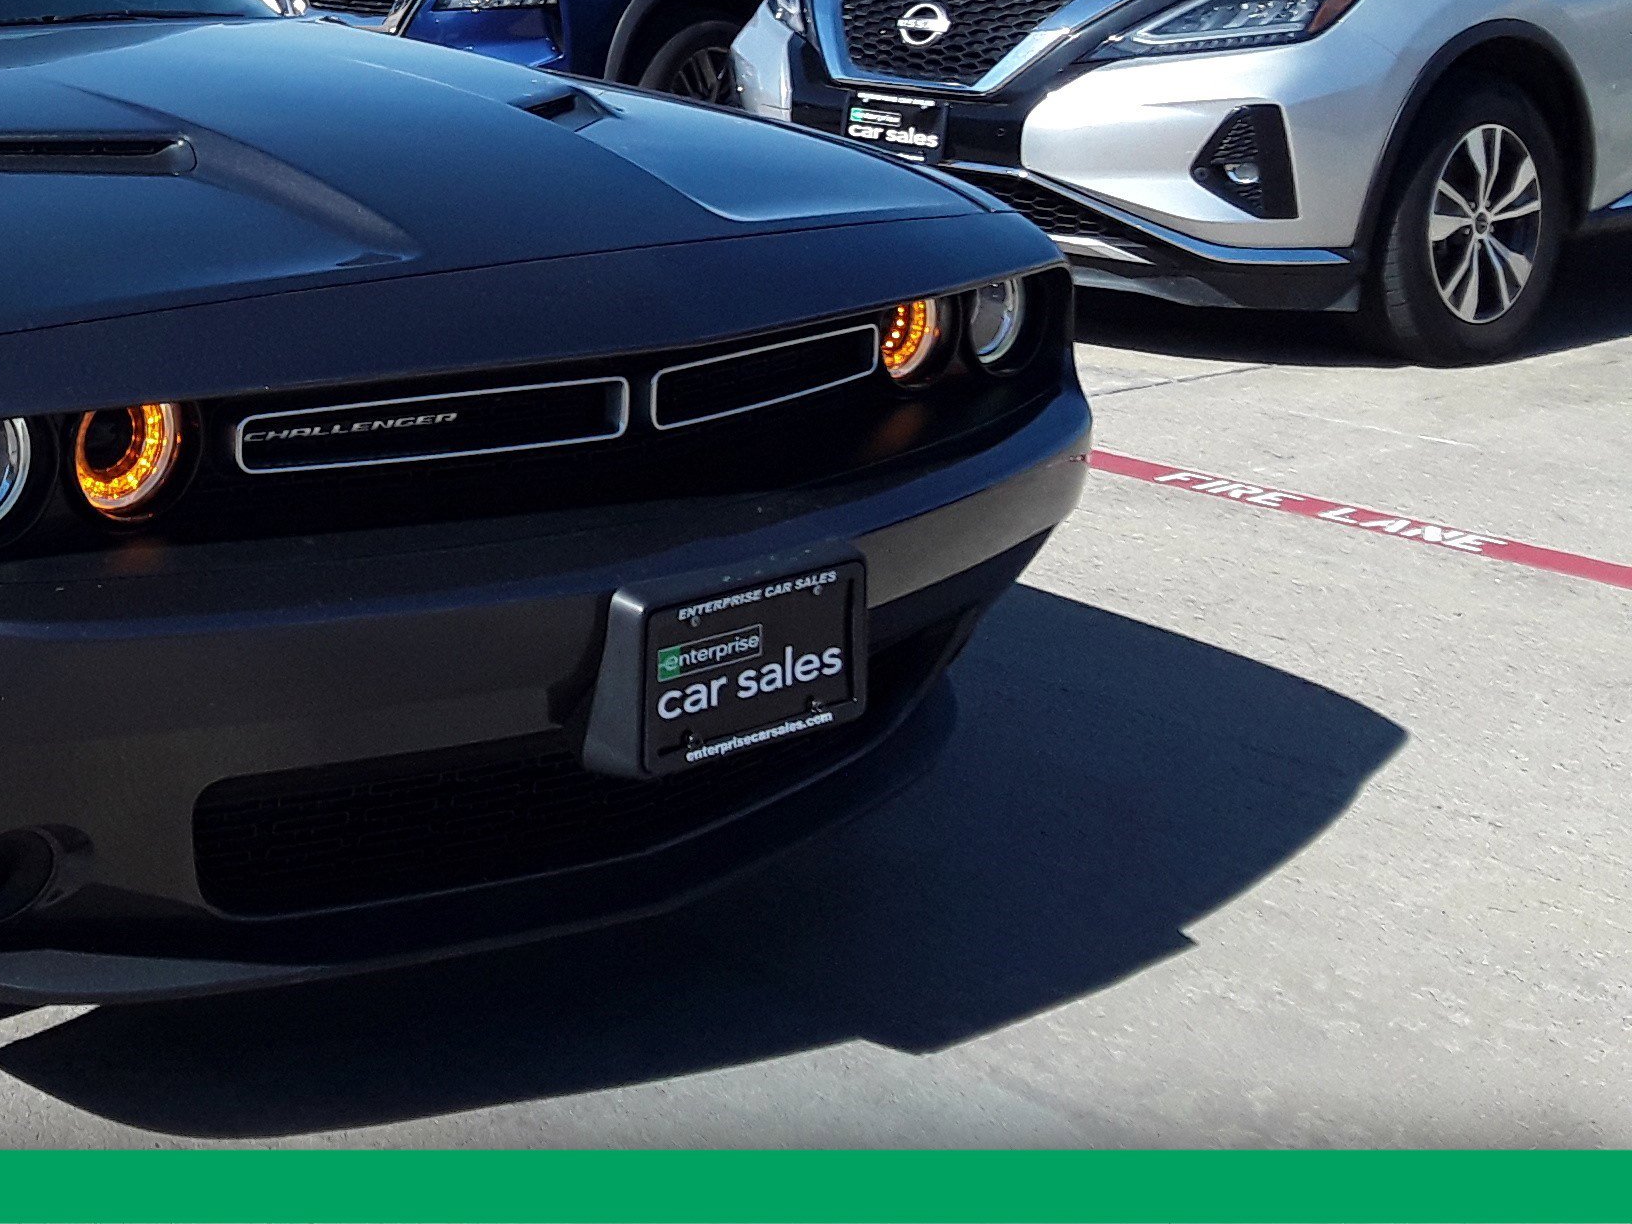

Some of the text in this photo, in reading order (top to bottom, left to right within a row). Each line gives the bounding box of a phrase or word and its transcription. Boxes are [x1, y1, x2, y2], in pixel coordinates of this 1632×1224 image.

[848, 124, 939, 148] car sales
[244, 412, 458, 443] CHALLENGER
[1154, 470, 1509, 553] FIRE LANE
[678, 570, 838, 621] ENTERPRISE CAR SALES
[663, 634, 761, 672] enterprise
[657, 645, 844, 720] car sales
[685, 711, 834, 763] enterprisecarsales.com
